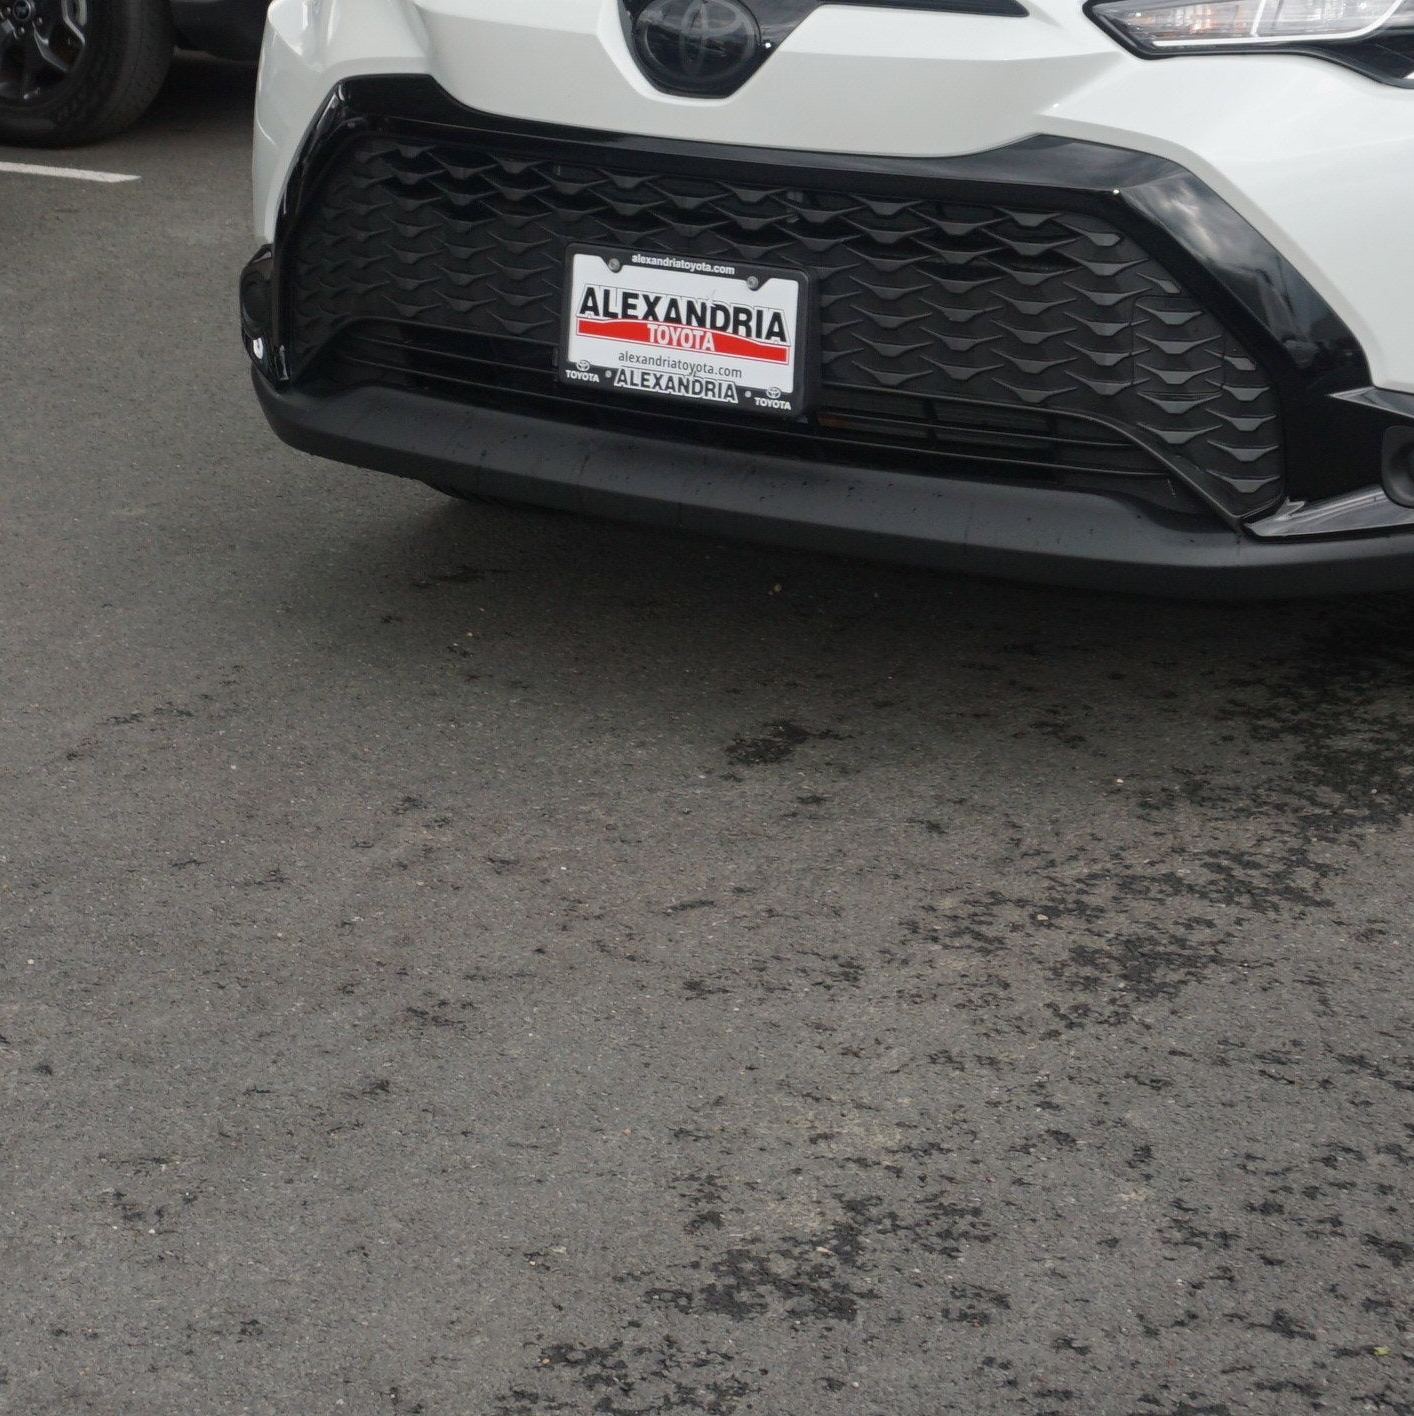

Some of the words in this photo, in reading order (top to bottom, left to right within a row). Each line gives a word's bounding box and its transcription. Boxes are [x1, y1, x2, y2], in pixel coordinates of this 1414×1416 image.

[631, 253, 735, 275] alexandriatoyota.com
[579, 286, 787, 342] ALEXANDRIA
[647, 323, 715, 352] TOYOTA
[618, 350, 742, 378] alexandriatoyota.com
[565, 369, 599, 383] TOYOTA
[615, 367, 738, 403] ALEXANDRIA
[754, 396, 792, 410] TOYOTA
